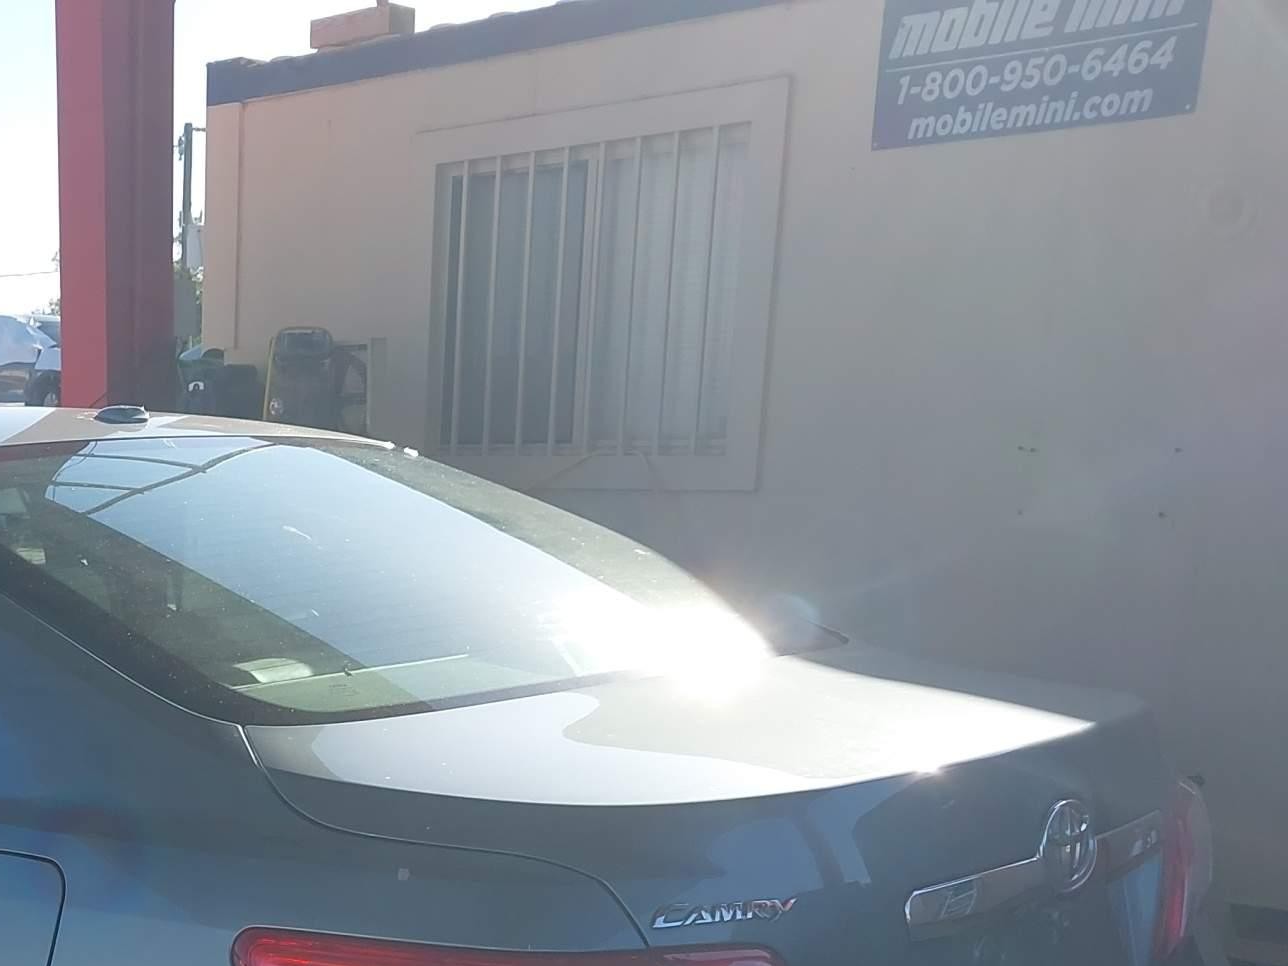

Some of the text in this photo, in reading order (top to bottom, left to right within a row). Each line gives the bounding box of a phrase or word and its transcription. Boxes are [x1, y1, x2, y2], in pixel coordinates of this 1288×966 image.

[888, 0, 1063, 60] mobile
[896, 35, 1178, 105] 1-800-950-6464
[907, 86, 1154, 141] mobilemini.com
[652, 898, 798, 929] CAMRY
